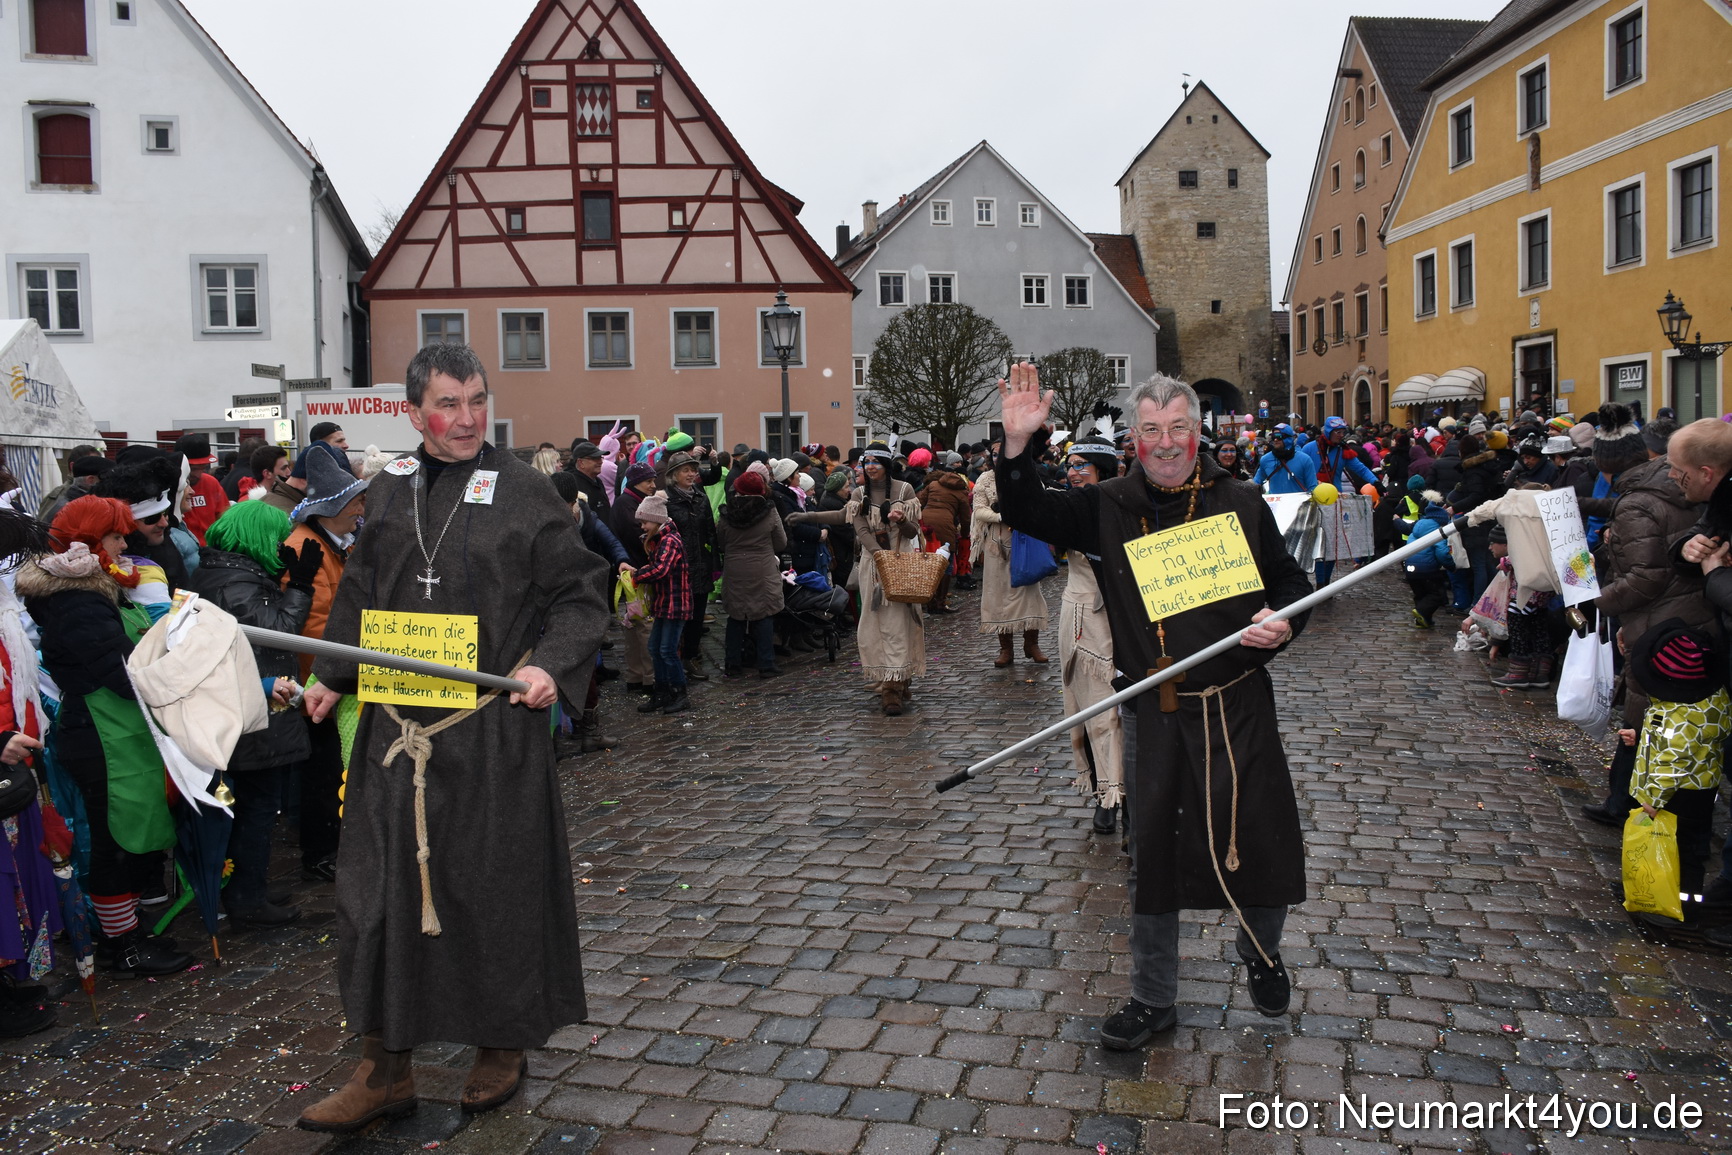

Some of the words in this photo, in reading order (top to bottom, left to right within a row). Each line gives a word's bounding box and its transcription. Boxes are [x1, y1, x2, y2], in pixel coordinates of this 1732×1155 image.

[288, 380, 327, 390] Probststraße
[1619, 367, 1641, 381] BW
[236, 396, 277, 406] Forstergasse
[1544, 512, 1561, 527] für
[1127, 520, 1223, 561] Verspekuliert
[1161, 553, 1187, 571] na
[1195, 539, 1227, 561] und
[1140, 577, 1162, 595] mit
[1164, 573, 1187, 588] dem
[1186, 549, 1255, 579] Klingelbeutel
[1151, 589, 1195, 616] läuft's
[1198, 583, 1231, 601] weiter
[1236, 573, 1262, 592] rund
[363, 613, 380, 635] Wo
[383, 618, 398, 635] ist
[402, 618, 438, 638] denn
[444, 622, 466, 640] die
[361, 678, 371, 692] in
[373, 681, 389, 694] den
[393, 681, 433, 698] Häusern
[439, 686, 468, 700] drin.
